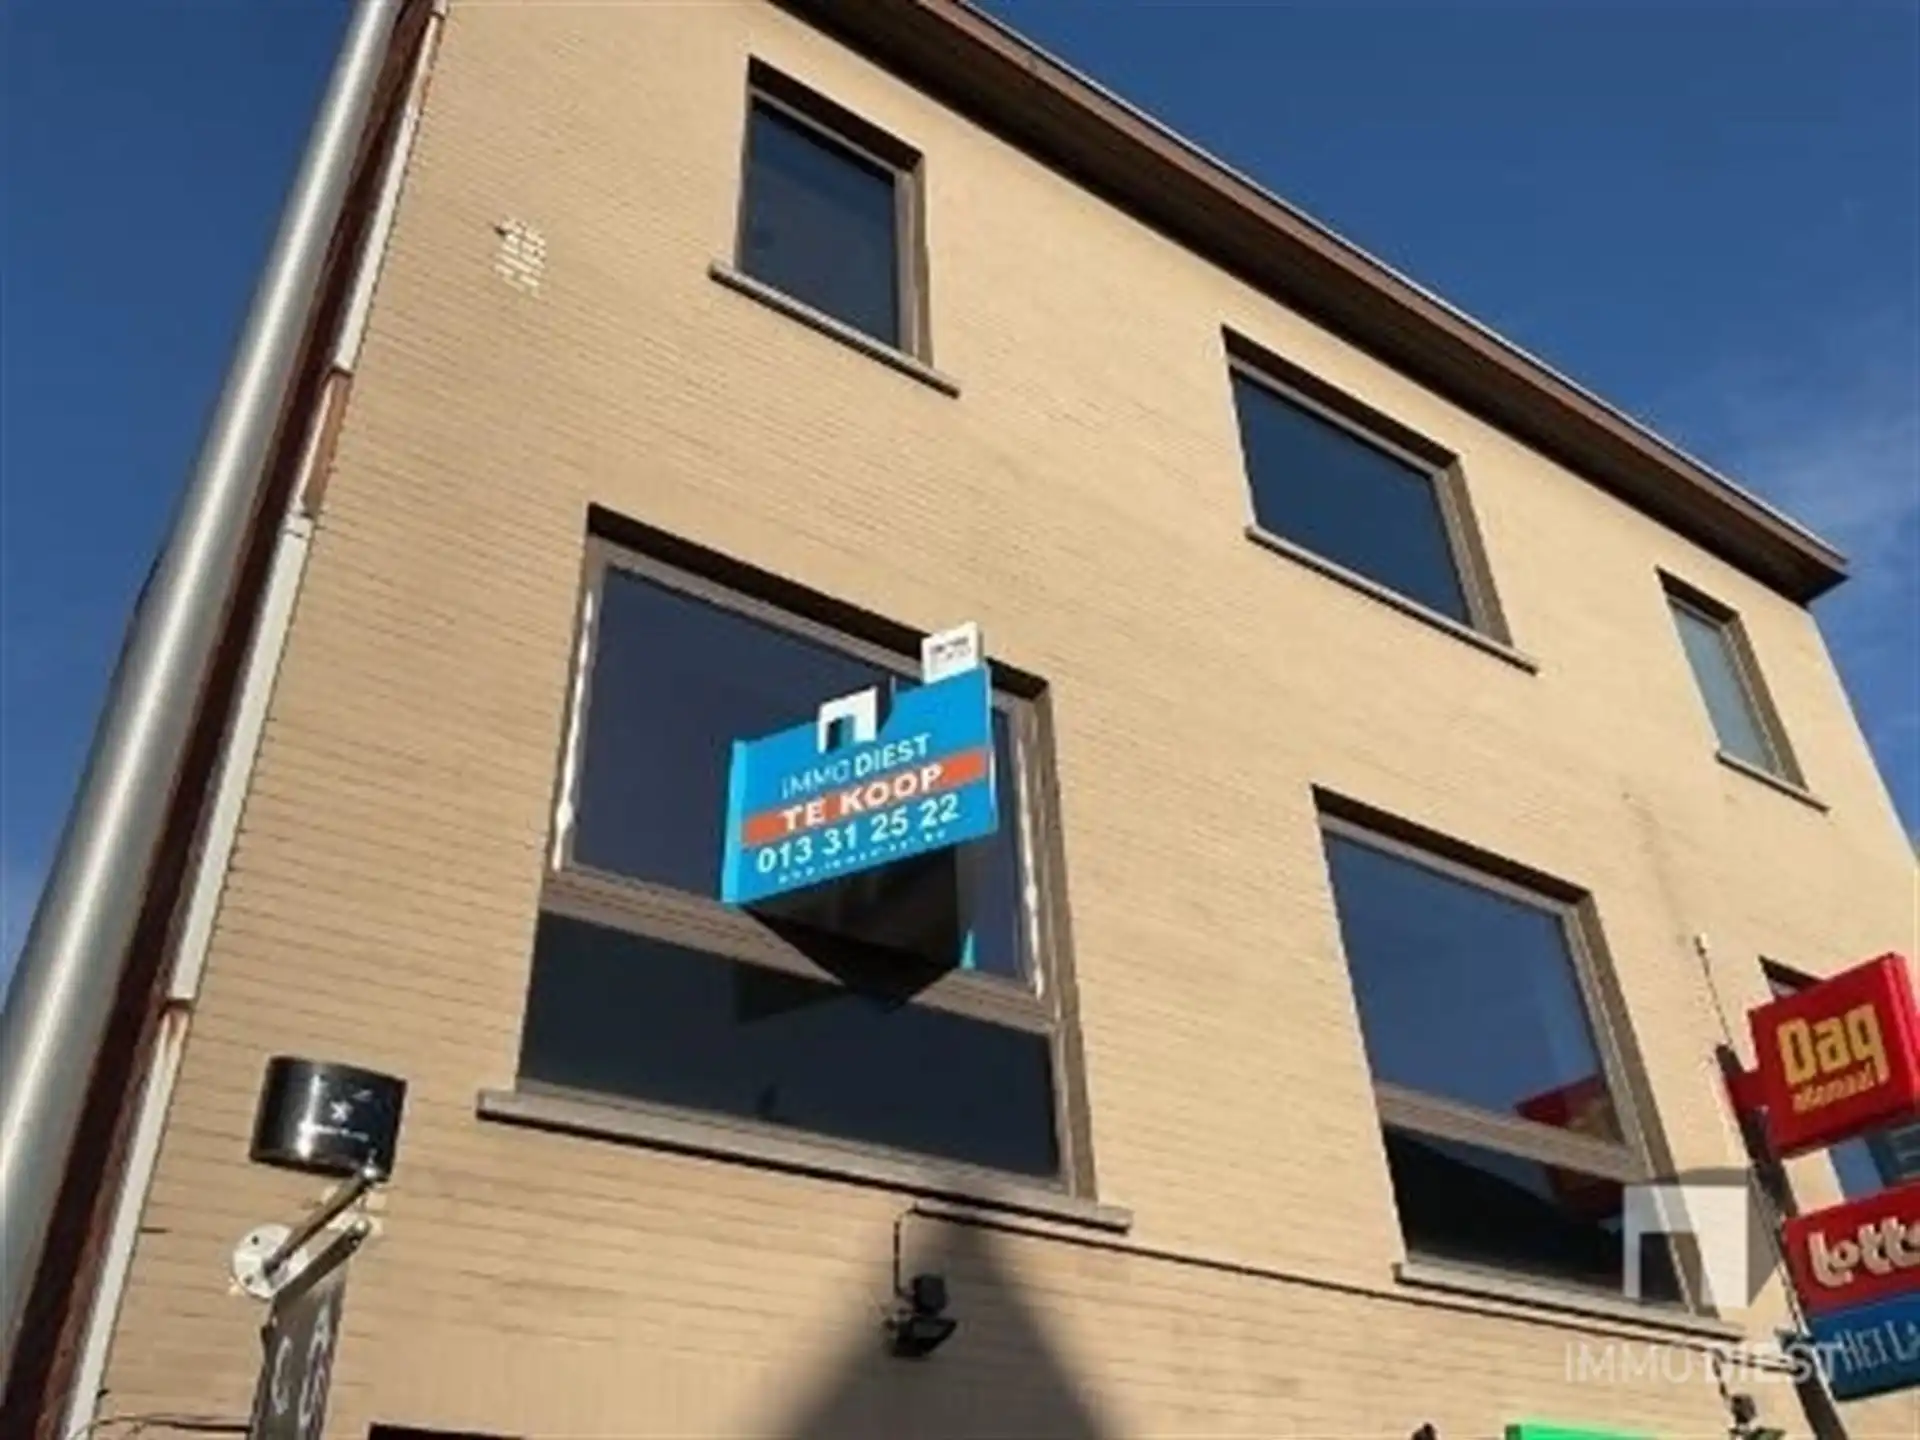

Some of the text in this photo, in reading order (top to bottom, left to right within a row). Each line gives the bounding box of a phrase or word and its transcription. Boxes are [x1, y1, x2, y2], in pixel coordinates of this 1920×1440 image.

[782, 733, 931, 799] IMMO DIEST
[782, 764, 943, 830] TE KOOP
[757, 836, 812, 873] 013
[822, 823, 856, 855] 31
[871, 807, 908, 842] 25
[920, 794, 960, 829] 22
[1777, 1003, 1890, 1088] Dag
